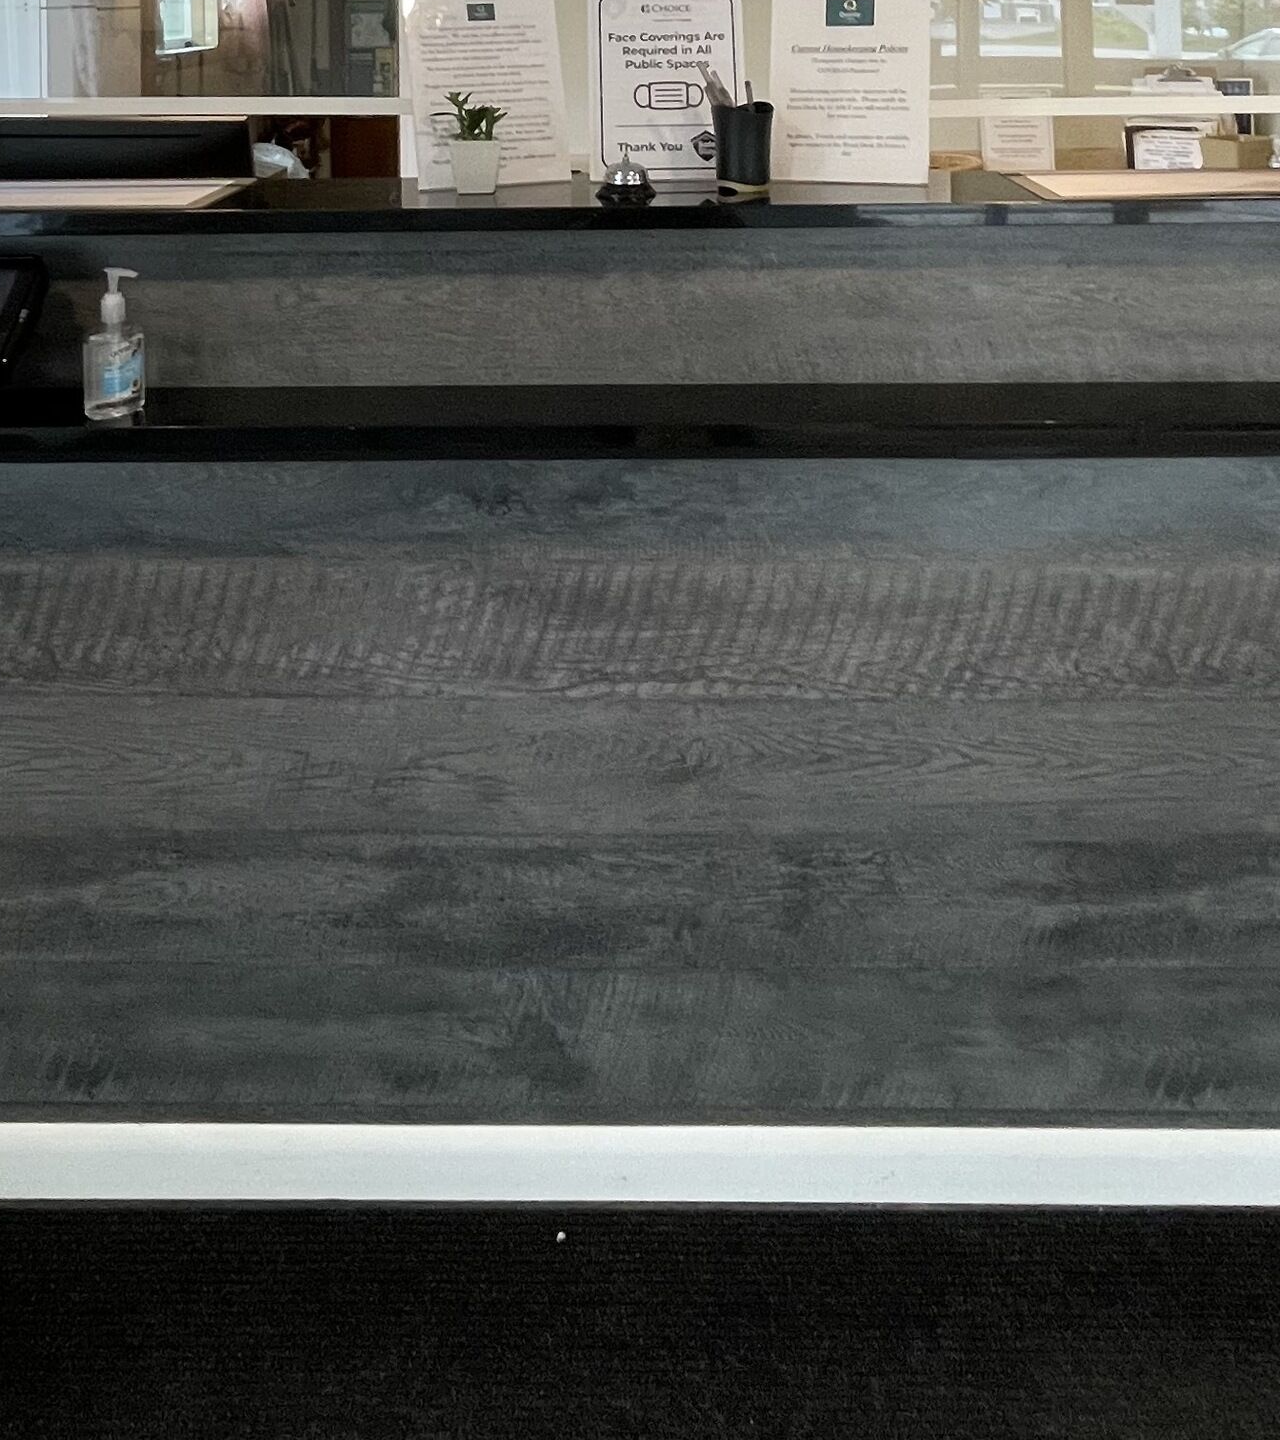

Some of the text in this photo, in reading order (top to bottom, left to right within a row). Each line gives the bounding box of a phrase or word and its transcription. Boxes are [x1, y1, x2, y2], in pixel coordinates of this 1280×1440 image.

[608, 31, 725, 44] Face Coverings Are
[622, 44, 712, 58] Required in All
[625, 59, 663, 70] Public
[617, 142, 683, 152] Thank You
